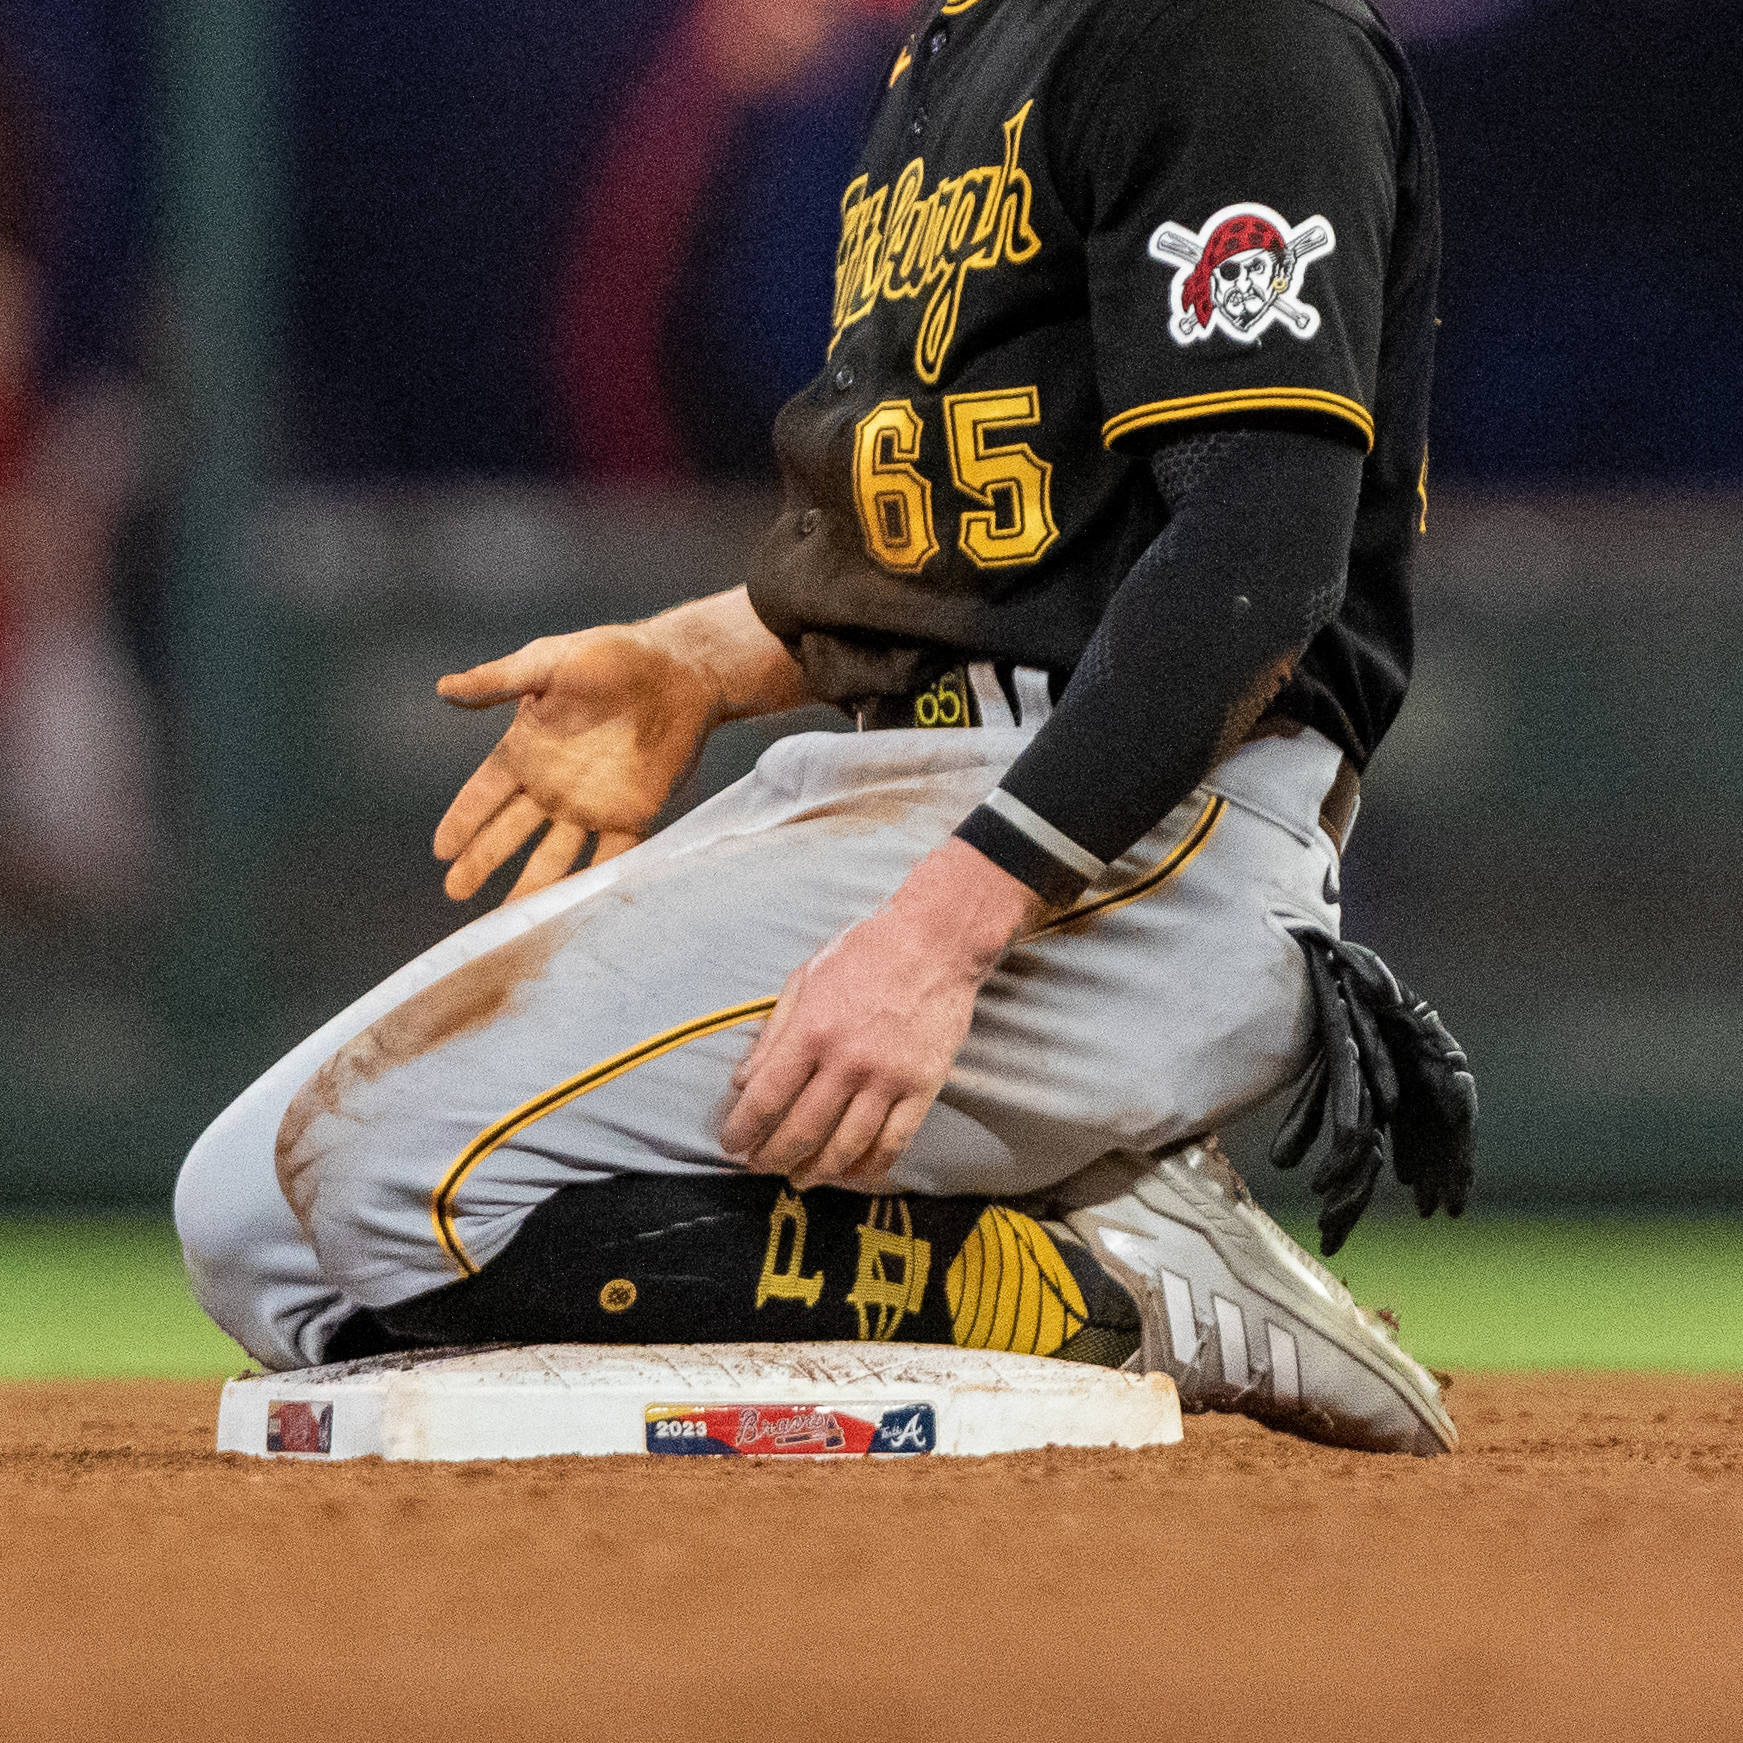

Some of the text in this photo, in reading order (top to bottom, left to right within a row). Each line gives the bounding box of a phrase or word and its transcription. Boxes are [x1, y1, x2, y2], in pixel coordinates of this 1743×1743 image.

[852, 385, 1059, 573] 65
[655, 1420, 708, 1438] 2023
[734, 1406, 826, 1448] Braves
